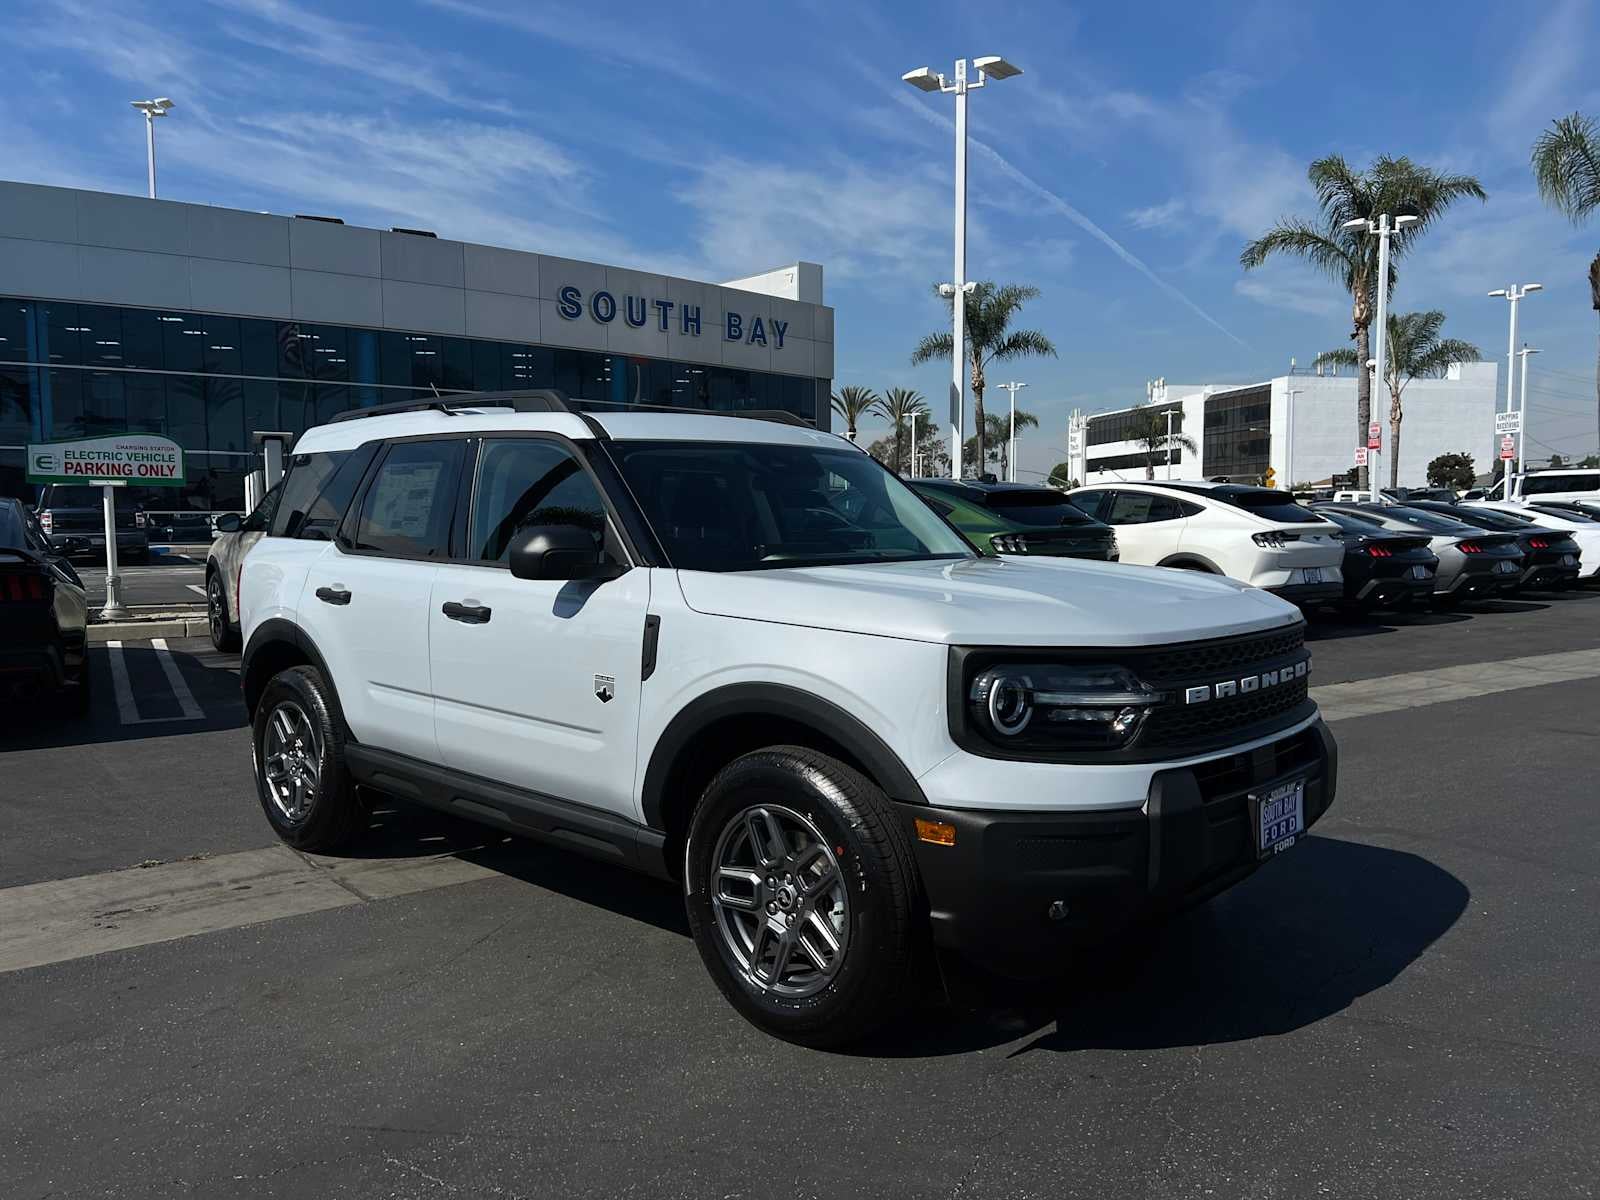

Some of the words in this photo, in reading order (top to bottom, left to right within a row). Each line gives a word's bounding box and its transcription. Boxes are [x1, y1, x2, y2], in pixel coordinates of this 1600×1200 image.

[559, 286, 701, 336] SOUTH
[726, 311, 788, 348] BAY
[64, 450, 123, 461] ELECTRIC
[125, 452, 176, 463] VEHICLE
[64, 462, 133, 476] PARKING
[137, 463, 176, 477] ONLY
[1185, 661, 1307, 704] BRONCO
[1264, 800, 1283, 824] SOUTH
[1284, 795, 1296, 814] BAY
[1264, 817, 1296, 844] FORD
[1274, 836, 1295, 855] FORD
